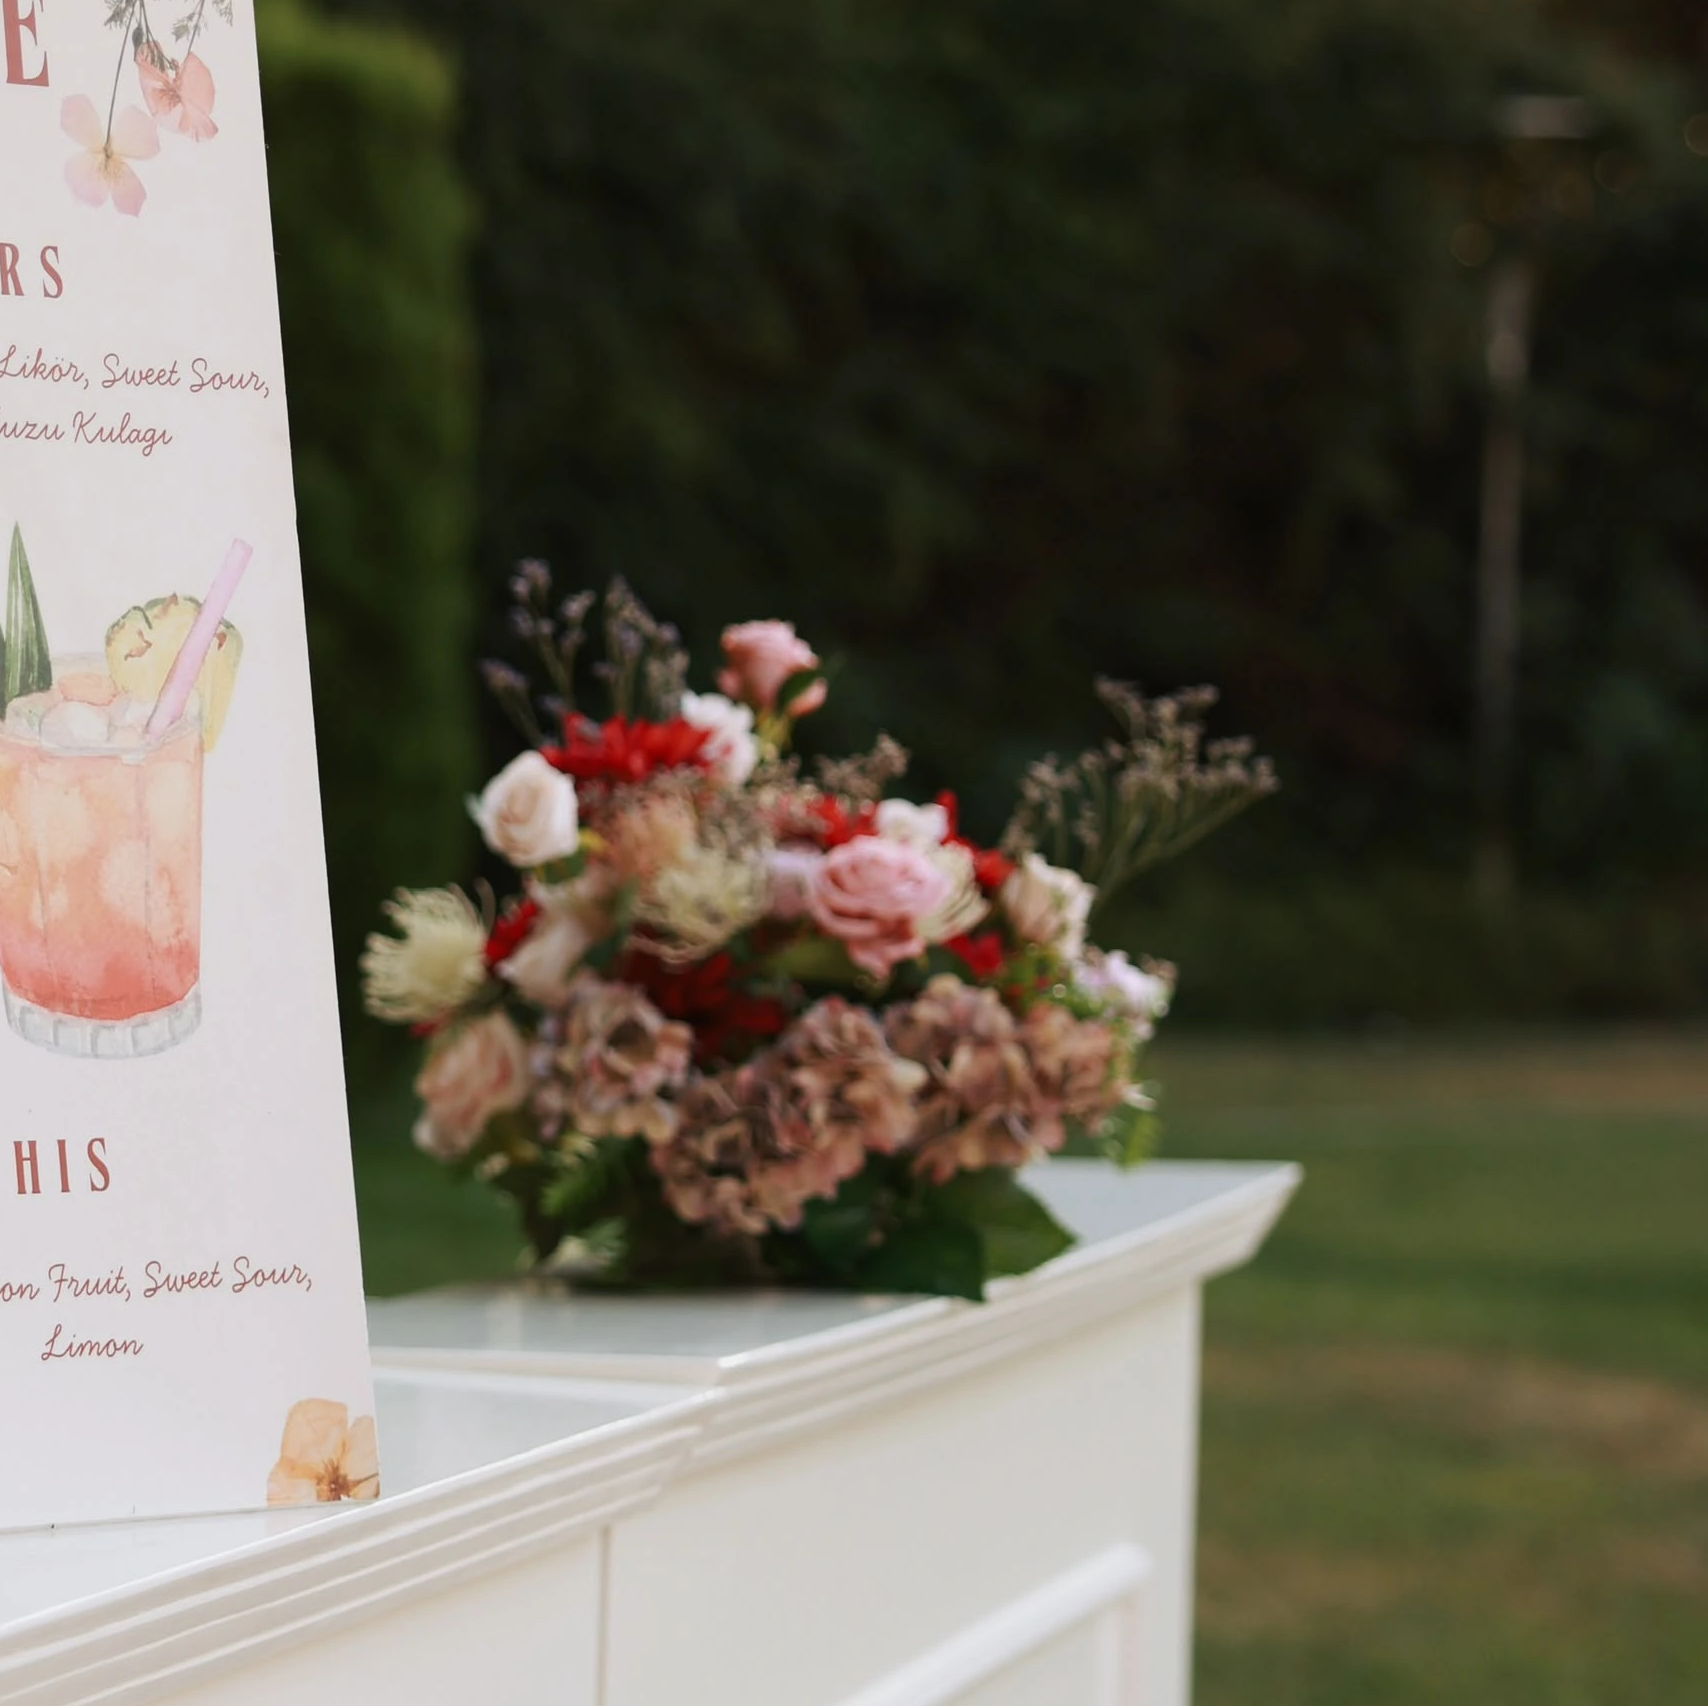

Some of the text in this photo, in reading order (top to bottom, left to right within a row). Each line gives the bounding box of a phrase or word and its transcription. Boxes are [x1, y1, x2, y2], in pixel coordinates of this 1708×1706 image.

[101, 353, 181, 389] Sweet
[189, 358, 270, 399] Sour,
[13, 1137, 111, 1194] HIS
[47, 1263, 132, 1302] Fruit,
[143, 1261, 224, 1297] Sweet
[232, 1256, 313, 1293] Sour,
[41, 1324, 144, 1360] Limon
